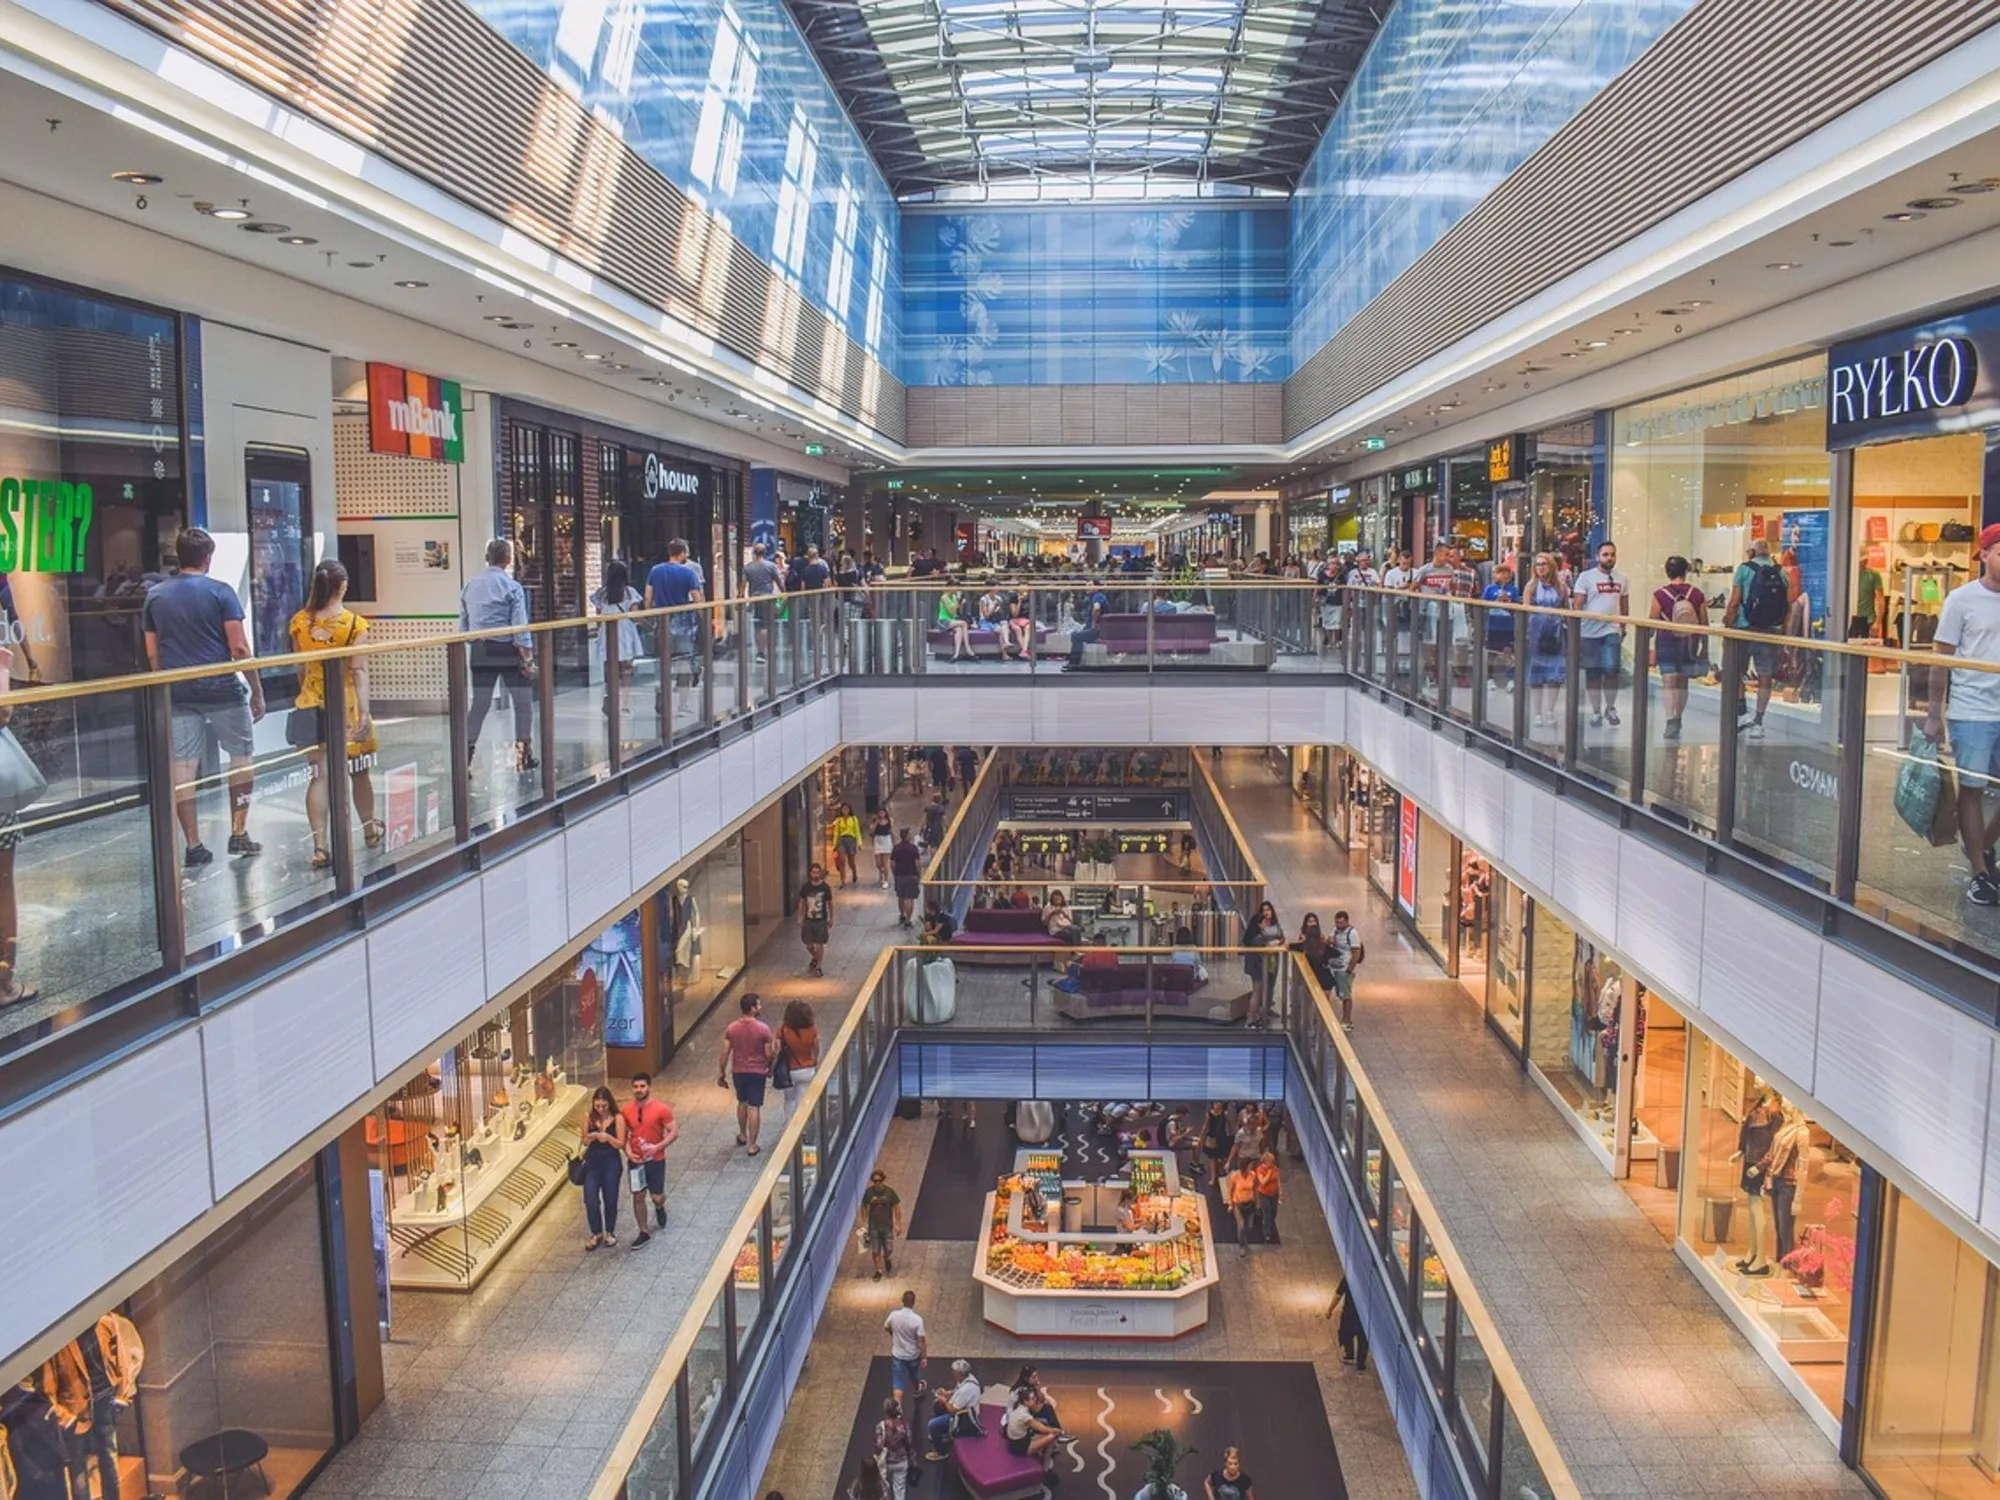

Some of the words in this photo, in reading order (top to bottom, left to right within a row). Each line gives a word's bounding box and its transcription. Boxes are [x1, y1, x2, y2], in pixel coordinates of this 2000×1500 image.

[388, 395, 458, 441] mBank
[1832, 338, 1960, 425] RYŁKO
[0, 477, 94, 574] STER?
